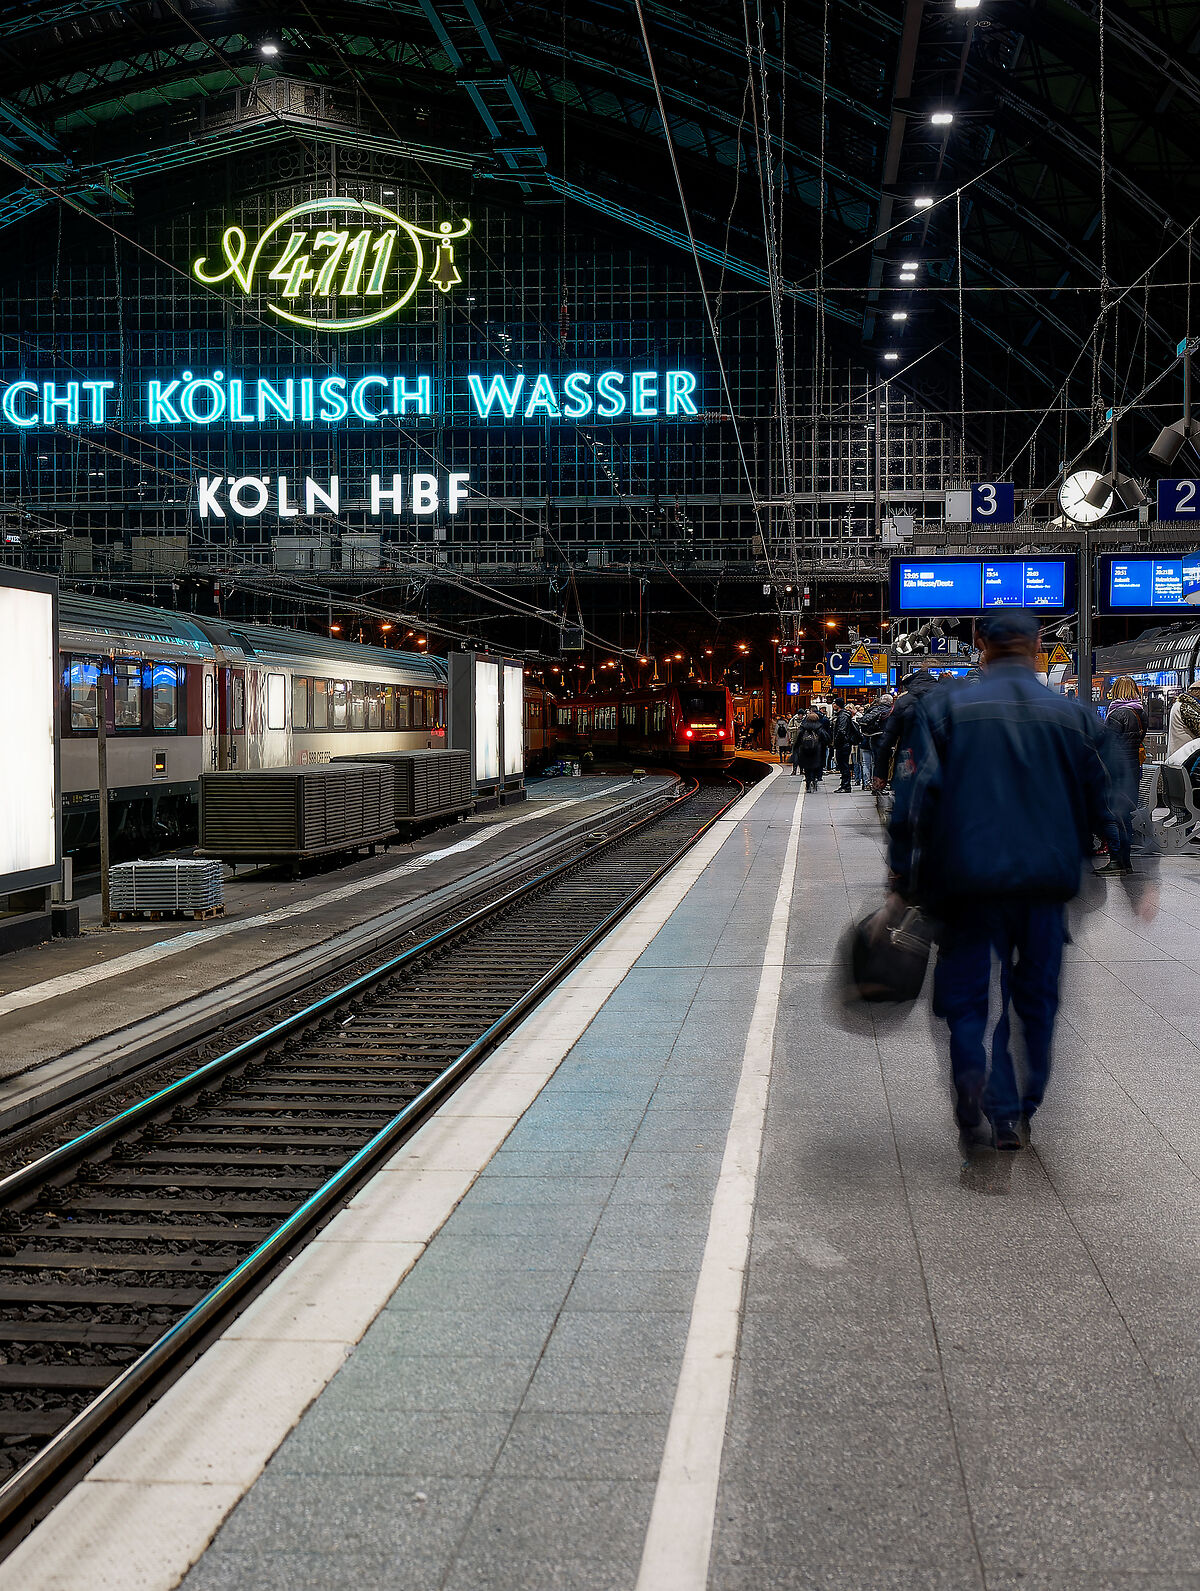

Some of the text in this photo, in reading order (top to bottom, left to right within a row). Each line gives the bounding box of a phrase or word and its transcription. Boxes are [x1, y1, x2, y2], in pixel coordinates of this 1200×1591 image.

[268, 229, 397, 298] 4711
[148, 370, 431, 425] KÖLNISCH
[467, 370, 698, 420] WASSER
[199, 473, 470, 518] KÖLN HBF
[976, 483, 998, 516] 3
[1174, 480, 1197, 513] 2
[937, 637, 946, 650] 2
[829, 653, 843, 671] C
[790, 683, 799, 694] B
